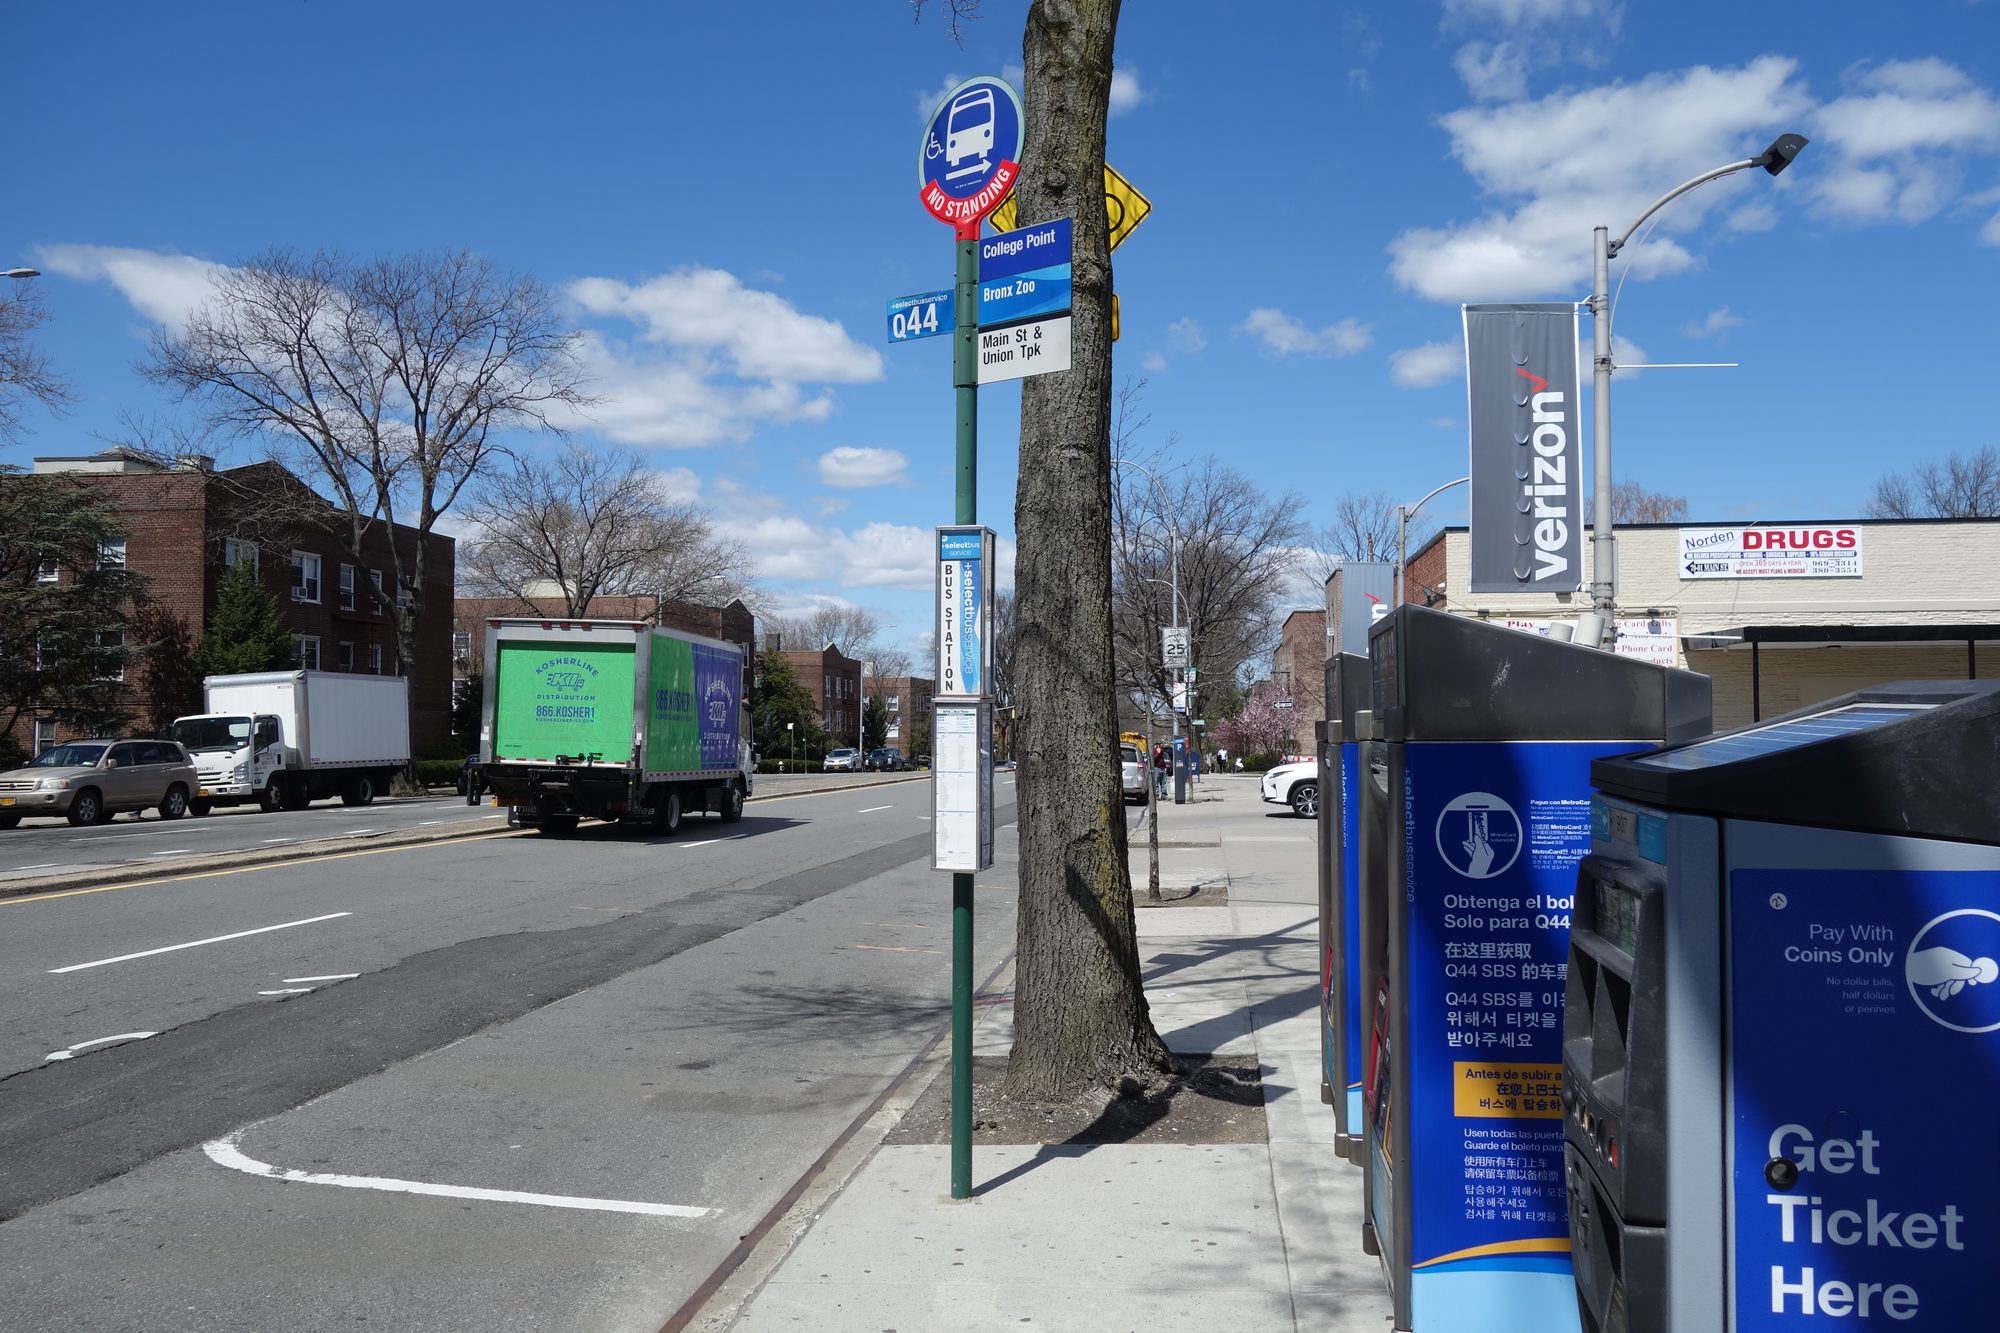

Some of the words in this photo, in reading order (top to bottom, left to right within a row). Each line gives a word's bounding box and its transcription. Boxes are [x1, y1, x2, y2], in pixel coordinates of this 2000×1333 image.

[926, 186, 943, 212] NO
[945, 167, 1011, 219] STANDING
[983, 237, 1024, 260] College
[1026, 229, 1056, 251] Point
[983, 285, 1013, 303] Bronx
[1015, 280, 1036, 296] Zoo
[892, 302, 939, 339] Q44
[983, 332, 1010, 349] Main
[1015, 328, 1028, 342] St
[1033, 326, 1042, 340] &
[983, 347, 1014, 365] Union
[1020, 342, 1042, 359] Tpk
[1524, 391, 1569, 581] verizon
[1685, 531, 1734, 550] Norden
[1742, 529, 1857, 550] DRUGS
[1754, 559, 1767, 567] 365
[945, 564, 953, 600] BUS
[945, 607, 953, 691] STATION
[1167, 643, 1185, 655] 25
[1650, 644, 1673, 652] Card
[536, 657, 599, 678] KOSHERLINE
[1648, 657, 1673, 665] ducts
[536, 705, 595, 718] 866.KOSHER1
[1177, 743, 1182, 751] P
[1444, 894, 1520, 911] Obtenga
[1525, 895, 1541, 909] el
[1444, 914, 1483, 929] Solo
[1489, 917, 1529, 931] para
[1535, 915, 1571, 930] Q44
[1809, 923, 1845, 944] Pay
[1850, 924, 1893, 941] With
[1445, 942, 1532, 959] 在这里获取
[1784, 946, 1843, 963] Coins
[1848, 947, 1895, 968] Only
[1445, 963, 1477, 978] Q44
[1481, 964, 1517, 978] SBS
[1826, 977, 1841, 986] No
[1843, 977, 1870, 986] dollar
[1872, 977, 1895, 988] bills,
[1445, 991, 1478, 1006] Q44
[1482, 991, 1534, 1008] SBS를
[1843, 990, 1861, 1000] half
[1862, 990, 1896, 1001] dollars
[1857, 1004, 1896, 1016] pennies
[1446, 1011, 1497, 1027] 위해서
[1506, 1012, 1557, 1028] 티켓을
[1447, 1031, 1533, 1048] 받아주세요
[1465, 1068, 1500, 1079] Antes
[1504, 1068, 1518, 1079] de
[1521, 1068, 1551, 1080] subir
[1479, 1098, 1516, 1110] 버스에
[1464, 1128, 1489, 1138] Usen
[1490, 1129, 1517, 1139] todas
[1518, 1130, 1533, 1139] las
[1464, 1141, 1499, 1151] Guarde
[1501, 1141, 1510, 1150] el
[1511, 1142, 1540, 1152] boleto
[1542, 1144, 1564, 1153] para
[1768, 1124, 1880, 1175] Get
[1464, 1155, 1549, 1168] 使用所有车门上车
[1464, 1168, 1559, 1181] 请保留车票以备检票
[1464, 1184, 1506, 1196] 탑승하기
[1511, 1185, 1542, 1197] 위해서
[1464, 1197, 1528, 1208] 사용해주세요
[1464, 1209, 1496, 1220] 검사를
[1500, 1210, 1521, 1221] 위해
[1525, 1211, 1556, 1222] 티켓을
[1767, 1194, 1964, 1250] Ticket
[1771, 1265, 1919, 1320] Here
